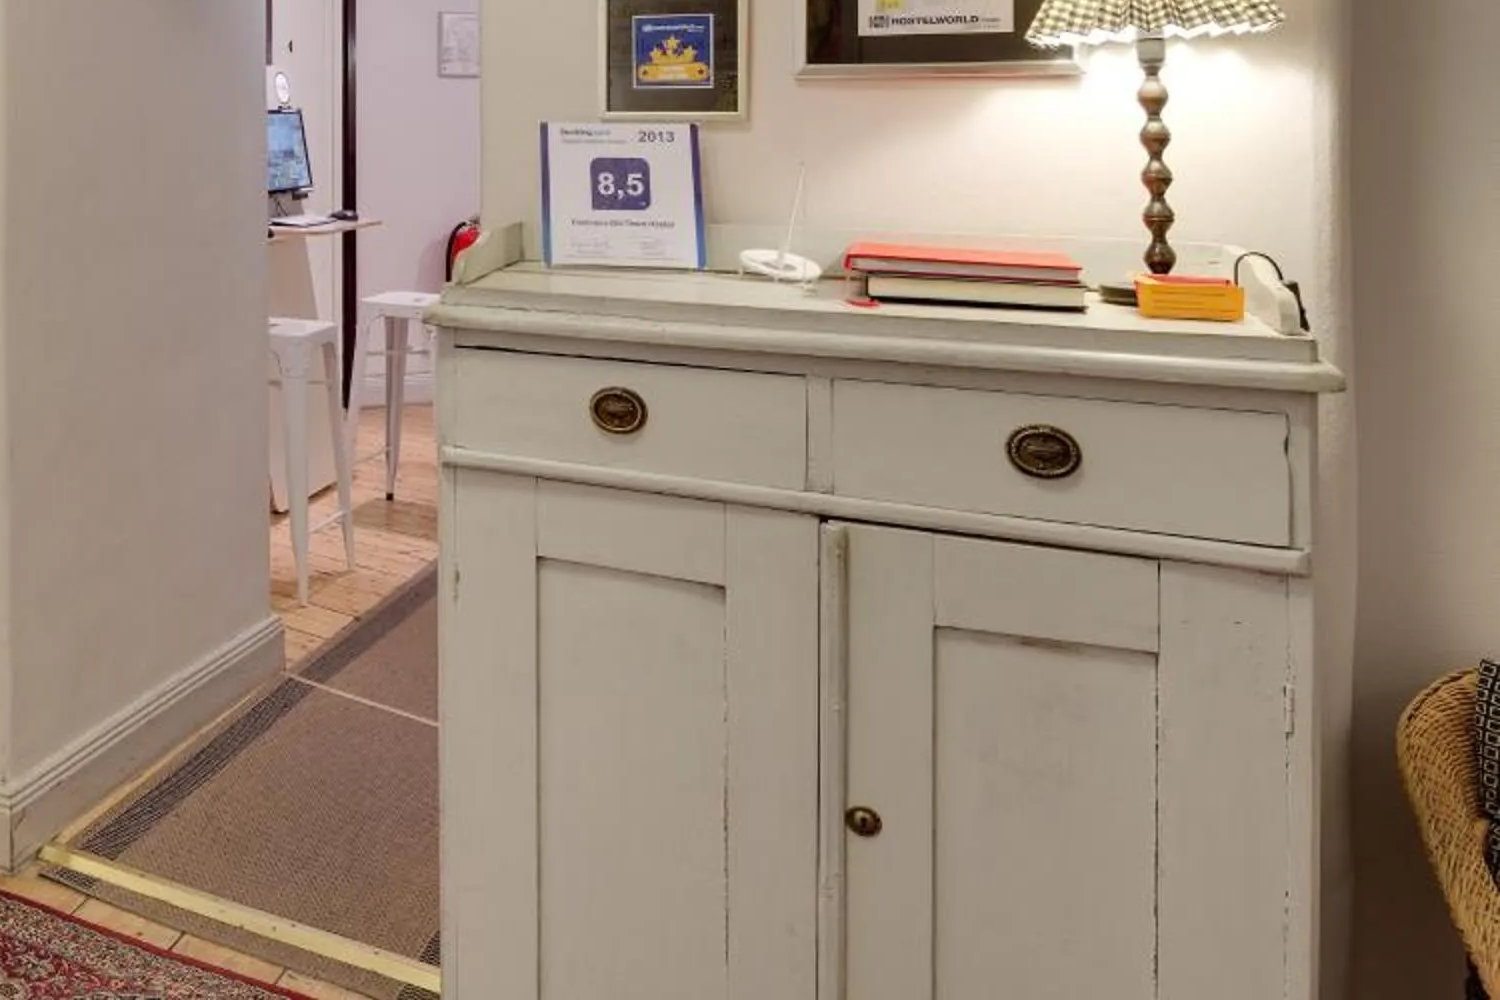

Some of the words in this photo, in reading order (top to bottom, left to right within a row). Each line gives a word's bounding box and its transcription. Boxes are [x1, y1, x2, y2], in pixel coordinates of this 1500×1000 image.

[891, 15, 1001, 26] HOSTELWORLD
[638, 130, 676, 144] 2013
[597, 171, 645, 201] 8,5
